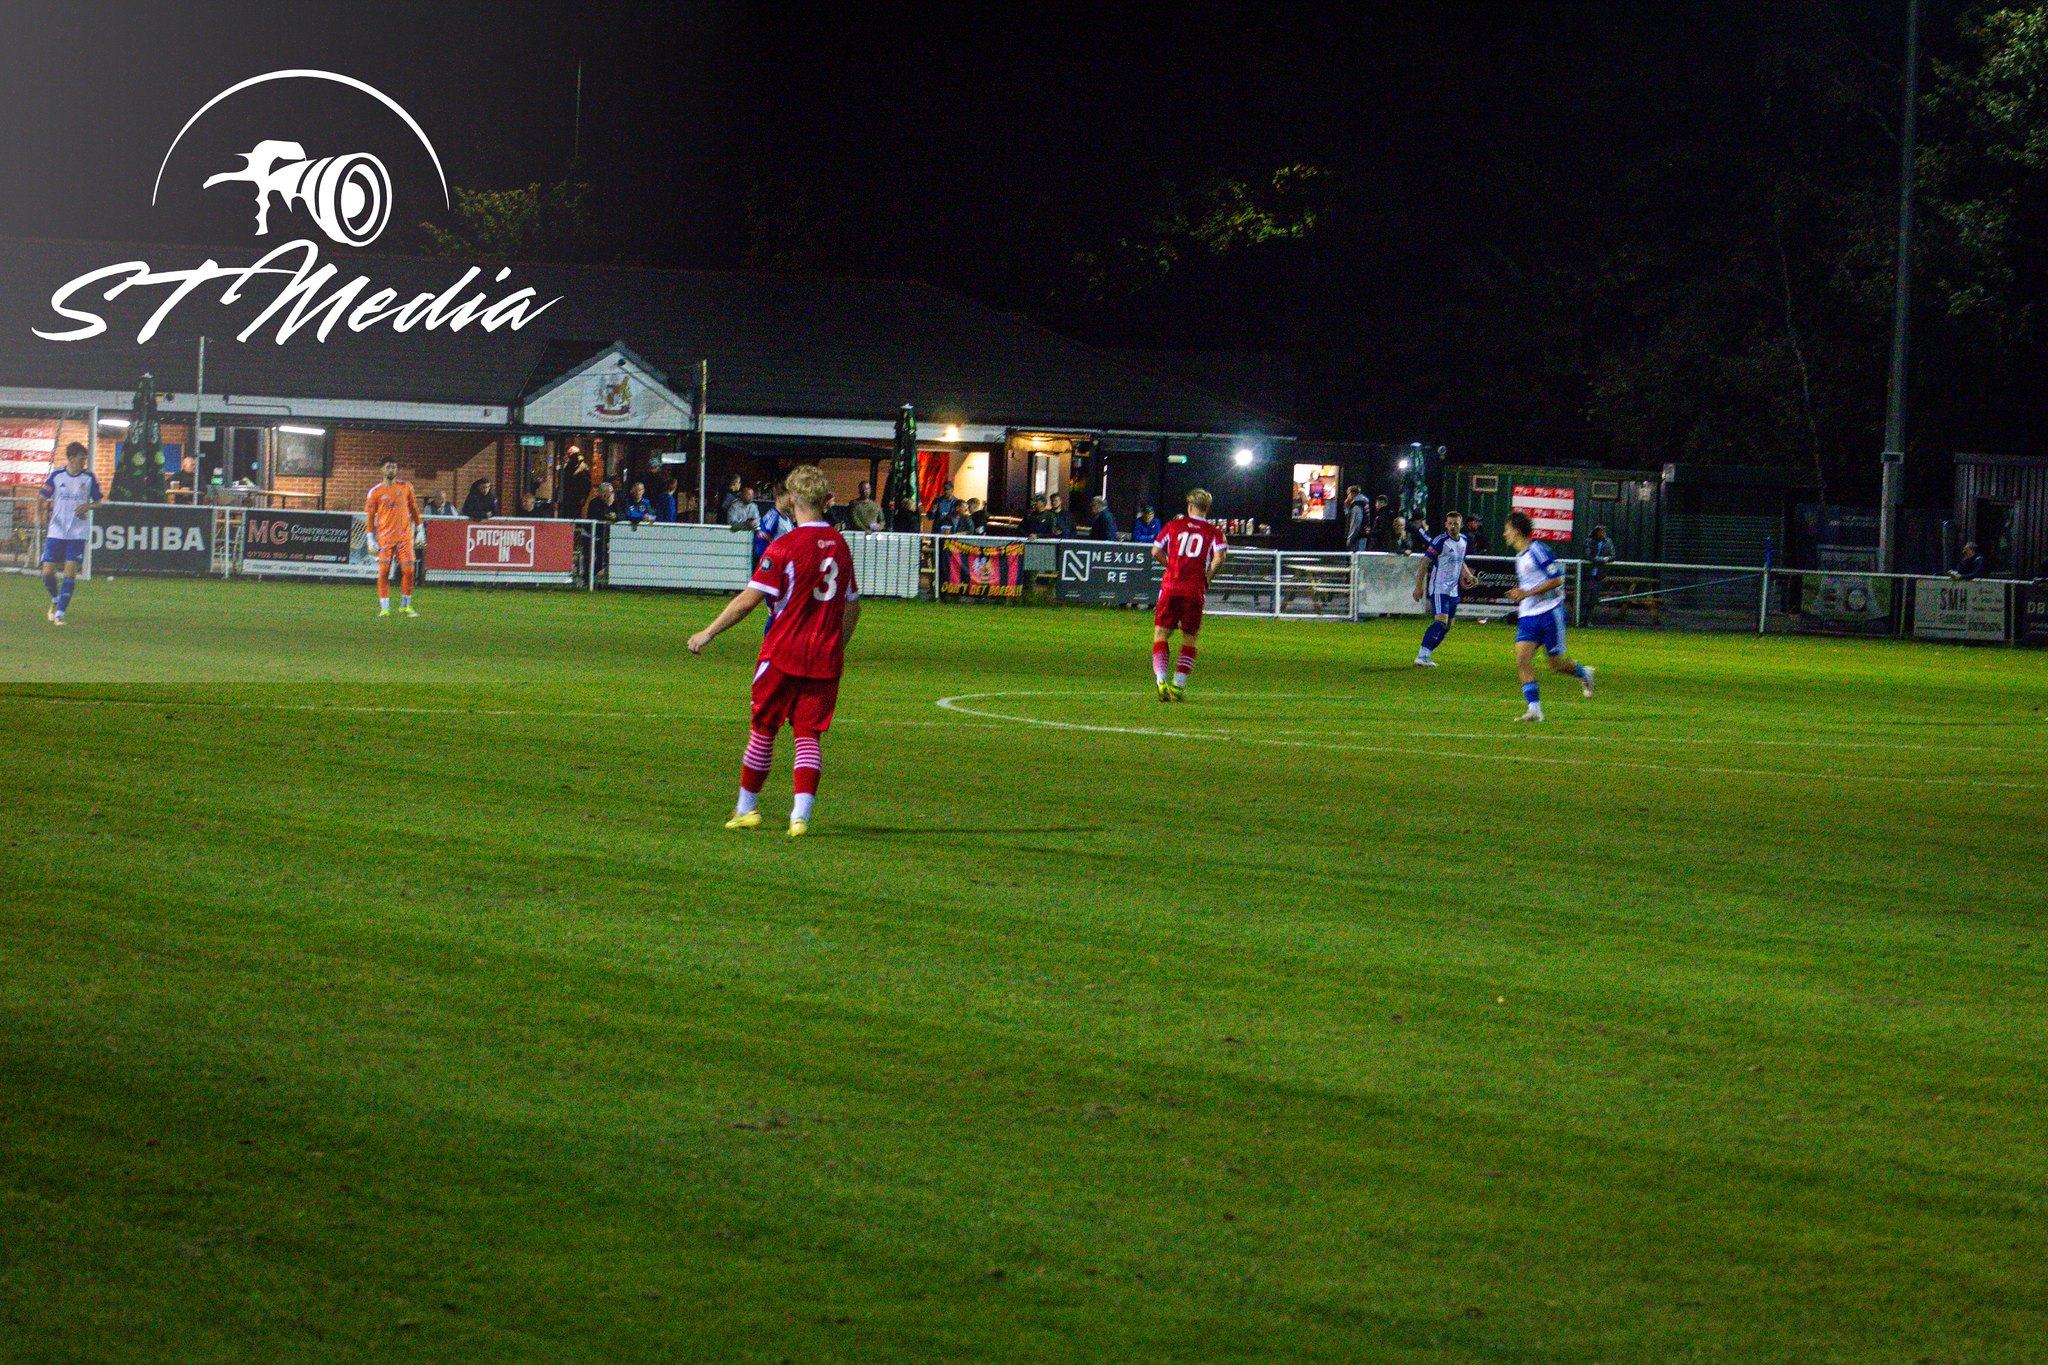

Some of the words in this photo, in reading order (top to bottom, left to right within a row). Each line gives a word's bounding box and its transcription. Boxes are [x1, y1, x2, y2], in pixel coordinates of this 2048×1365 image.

[90, 526, 205, 551] OSHIBA
[247, 520, 289, 544] MG
[476, 529, 525, 547] PITCHING
[498, 546, 510, 562] IN
[1177, 531, 1203, 558] 10
[1092, 551, 1145, 564] NEXUS
[813, 557, 839, 601] 3
[1107, 571, 1128, 583] RE
